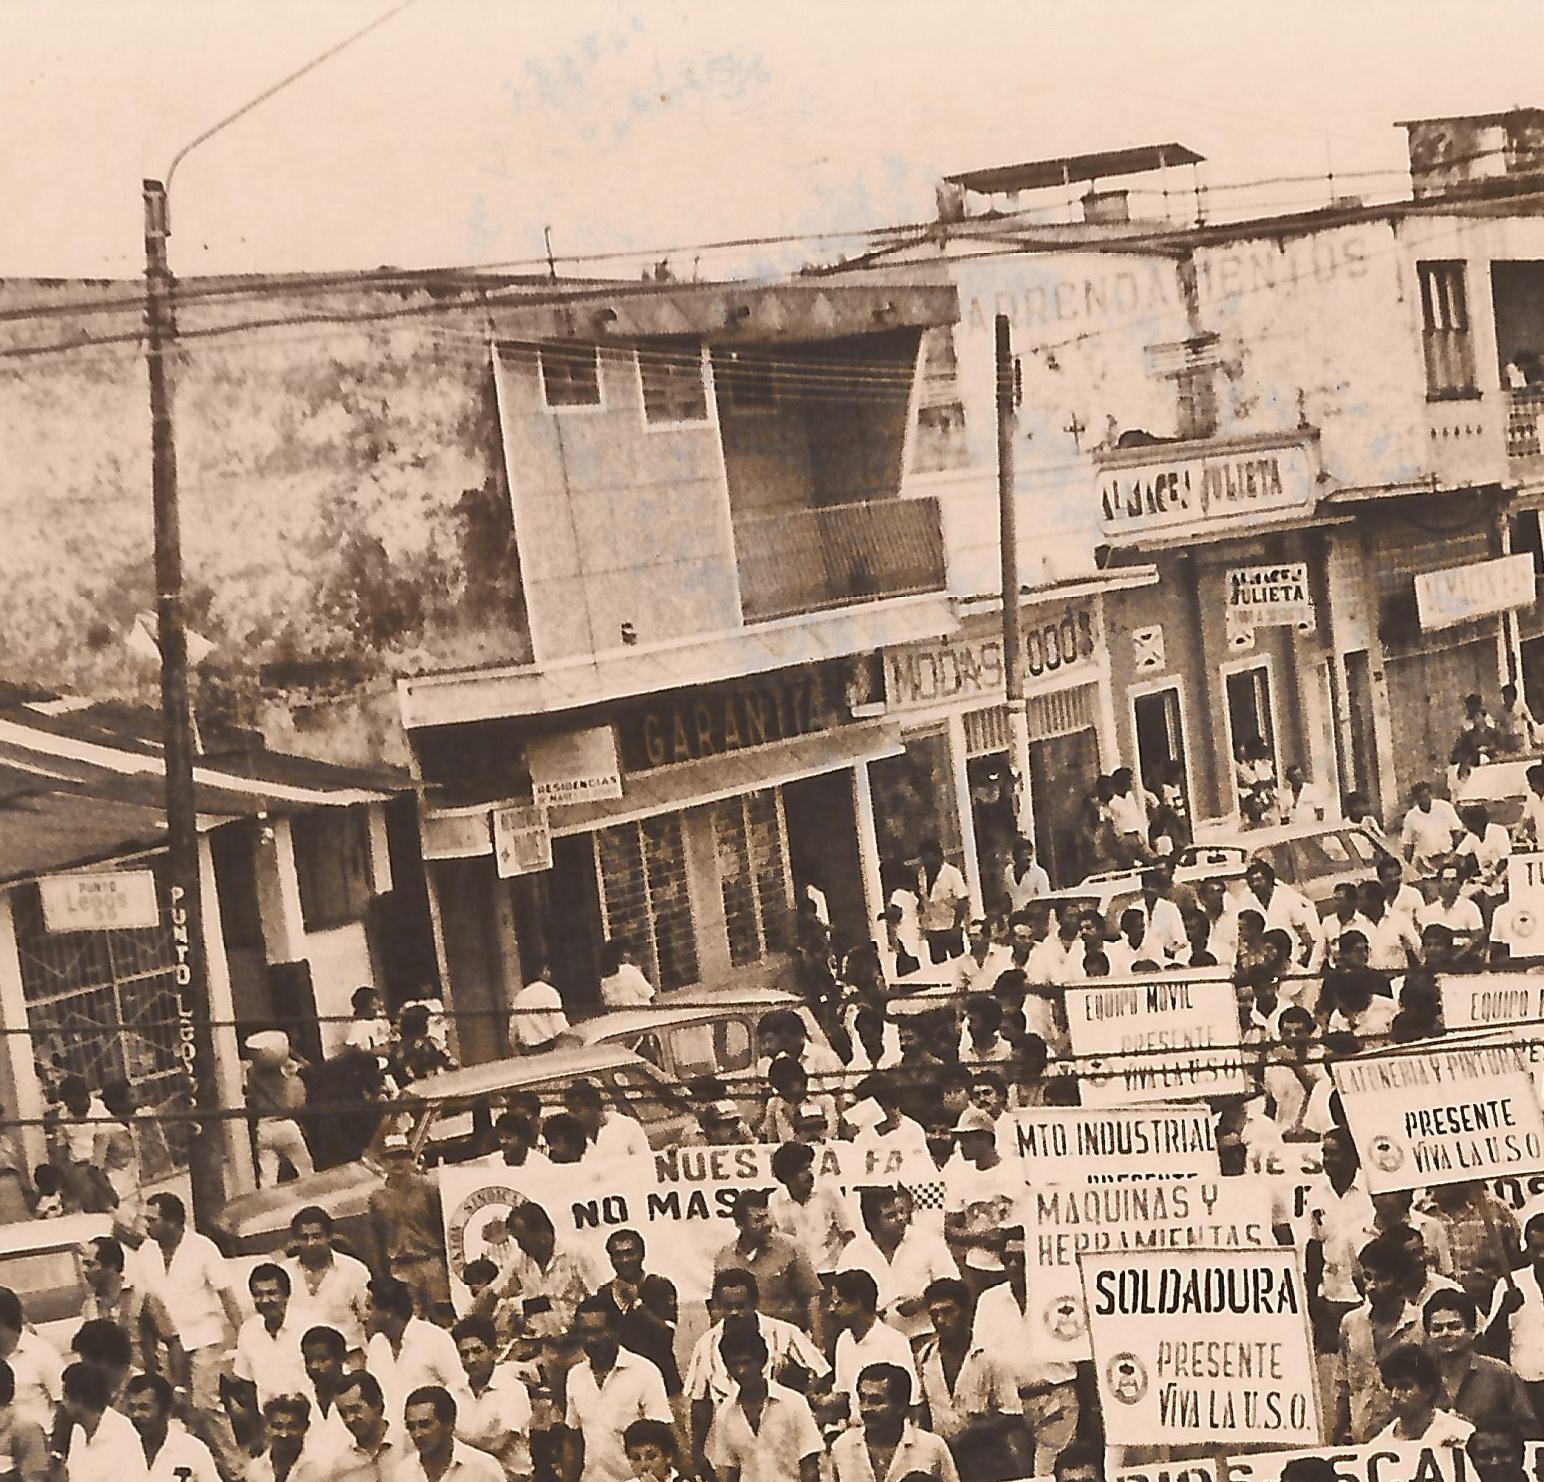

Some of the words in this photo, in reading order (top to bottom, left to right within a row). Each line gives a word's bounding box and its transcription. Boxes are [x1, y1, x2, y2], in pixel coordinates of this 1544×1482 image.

[1230, 585, 1305, 606] JULIETA
[170, 886, 192, 986] PUNTO
[1085, 988, 1138, 1021] EQUIPO
[1146, 982, 1194, 1013] MOVIL
[1470, 988, 1529, 1023] EQUIPO
[1076, 1116, 1216, 1156] INDUSTRIAL
[1404, 1098, 1516, 1139] PRESENTE
[654, 1147, 843, 1184] NUESA
[1411, 1140, 1453, 1174] VIVA
[1455, 1141, 1483, 1169] LA
[571, 1194, 629, 1230] NO
[646, 1186, 743, 1222] MAS
[1036, 1184, 1190, 1225] MAQUINAS
[1200, 1182, 1219, 1217] Y
[1094, 1267, 1299, 1315] SOLDADURA
[1156, 1339, 1284, 1380] PRESENTE
[1158, 1382, 1200, 1429] VIVA
[1209, 1389, 1237, 1429] LA
